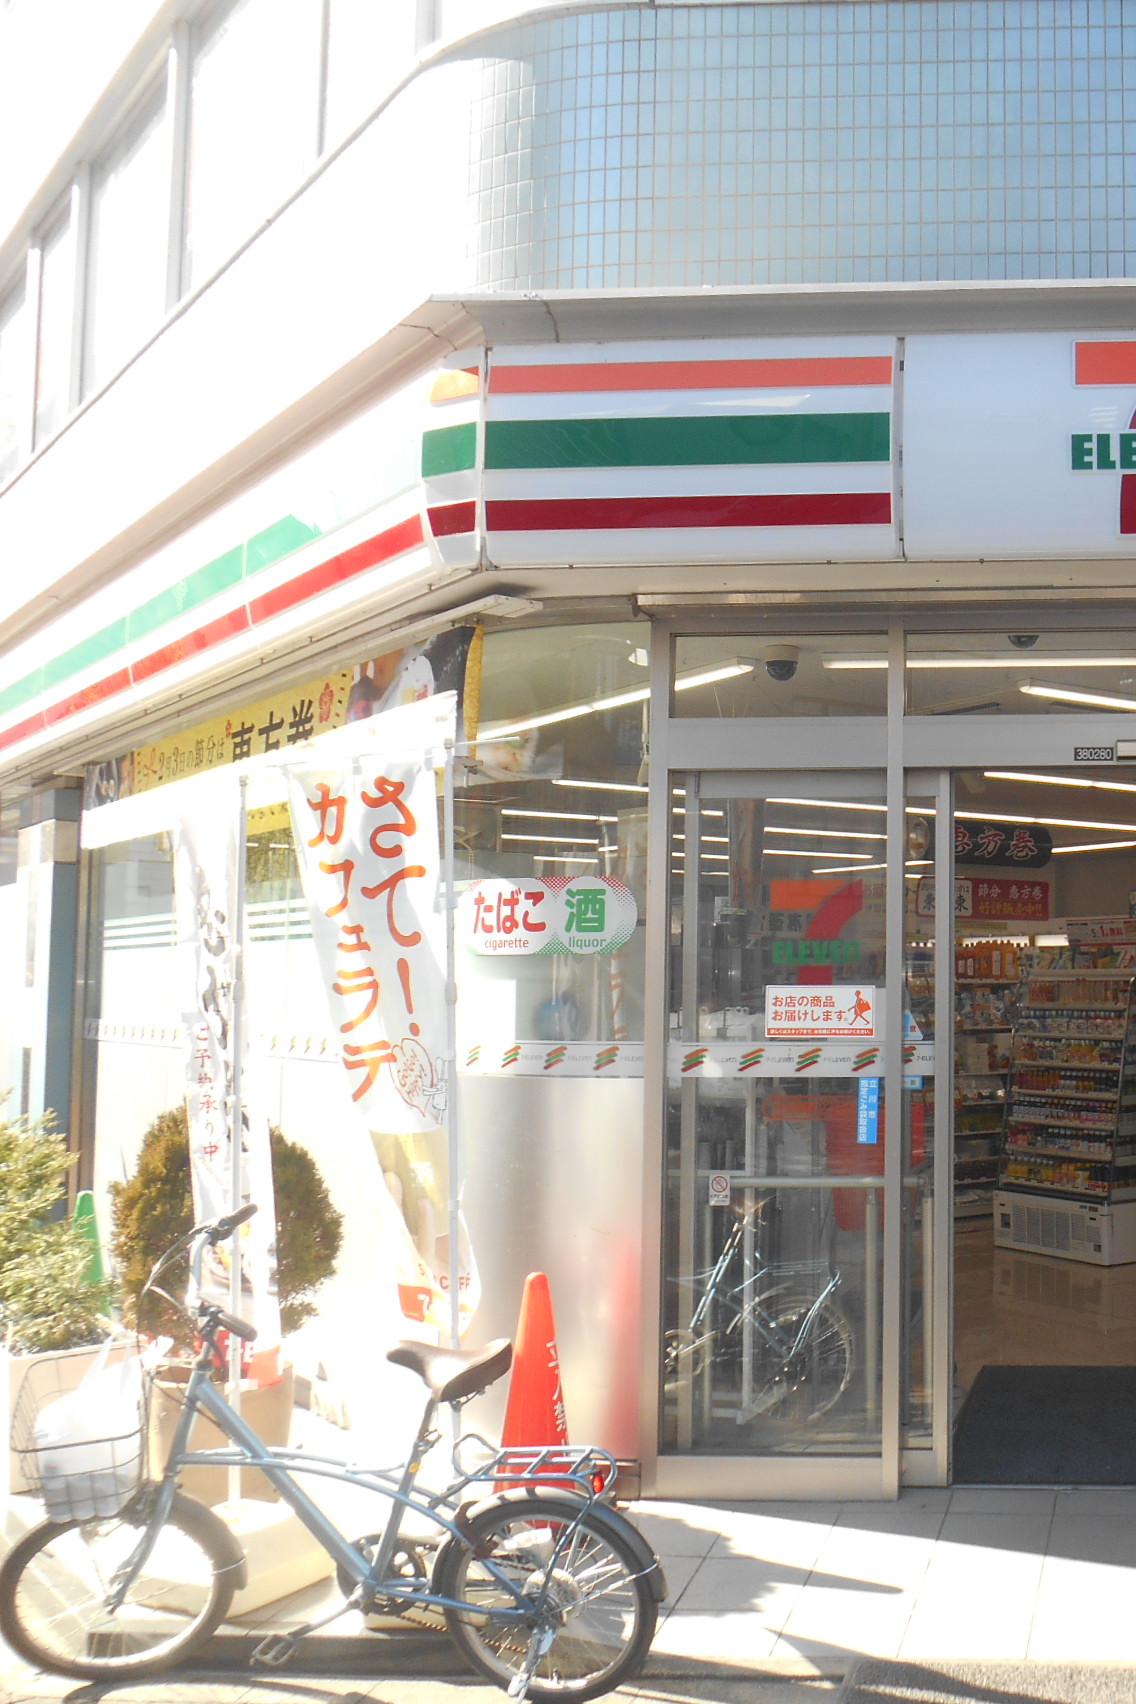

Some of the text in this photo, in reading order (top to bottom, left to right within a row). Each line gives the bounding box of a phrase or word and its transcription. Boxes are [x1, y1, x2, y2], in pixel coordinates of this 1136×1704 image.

[1076, 748, 1112, 760] 380280
[473, 887, 607, 934] たばこ 酒
[306, 782, 398, 1103] カフェラテ
[484, 936, 607, 951] cigarette liquor
[771, 995, 836, 1008] お店の商品
